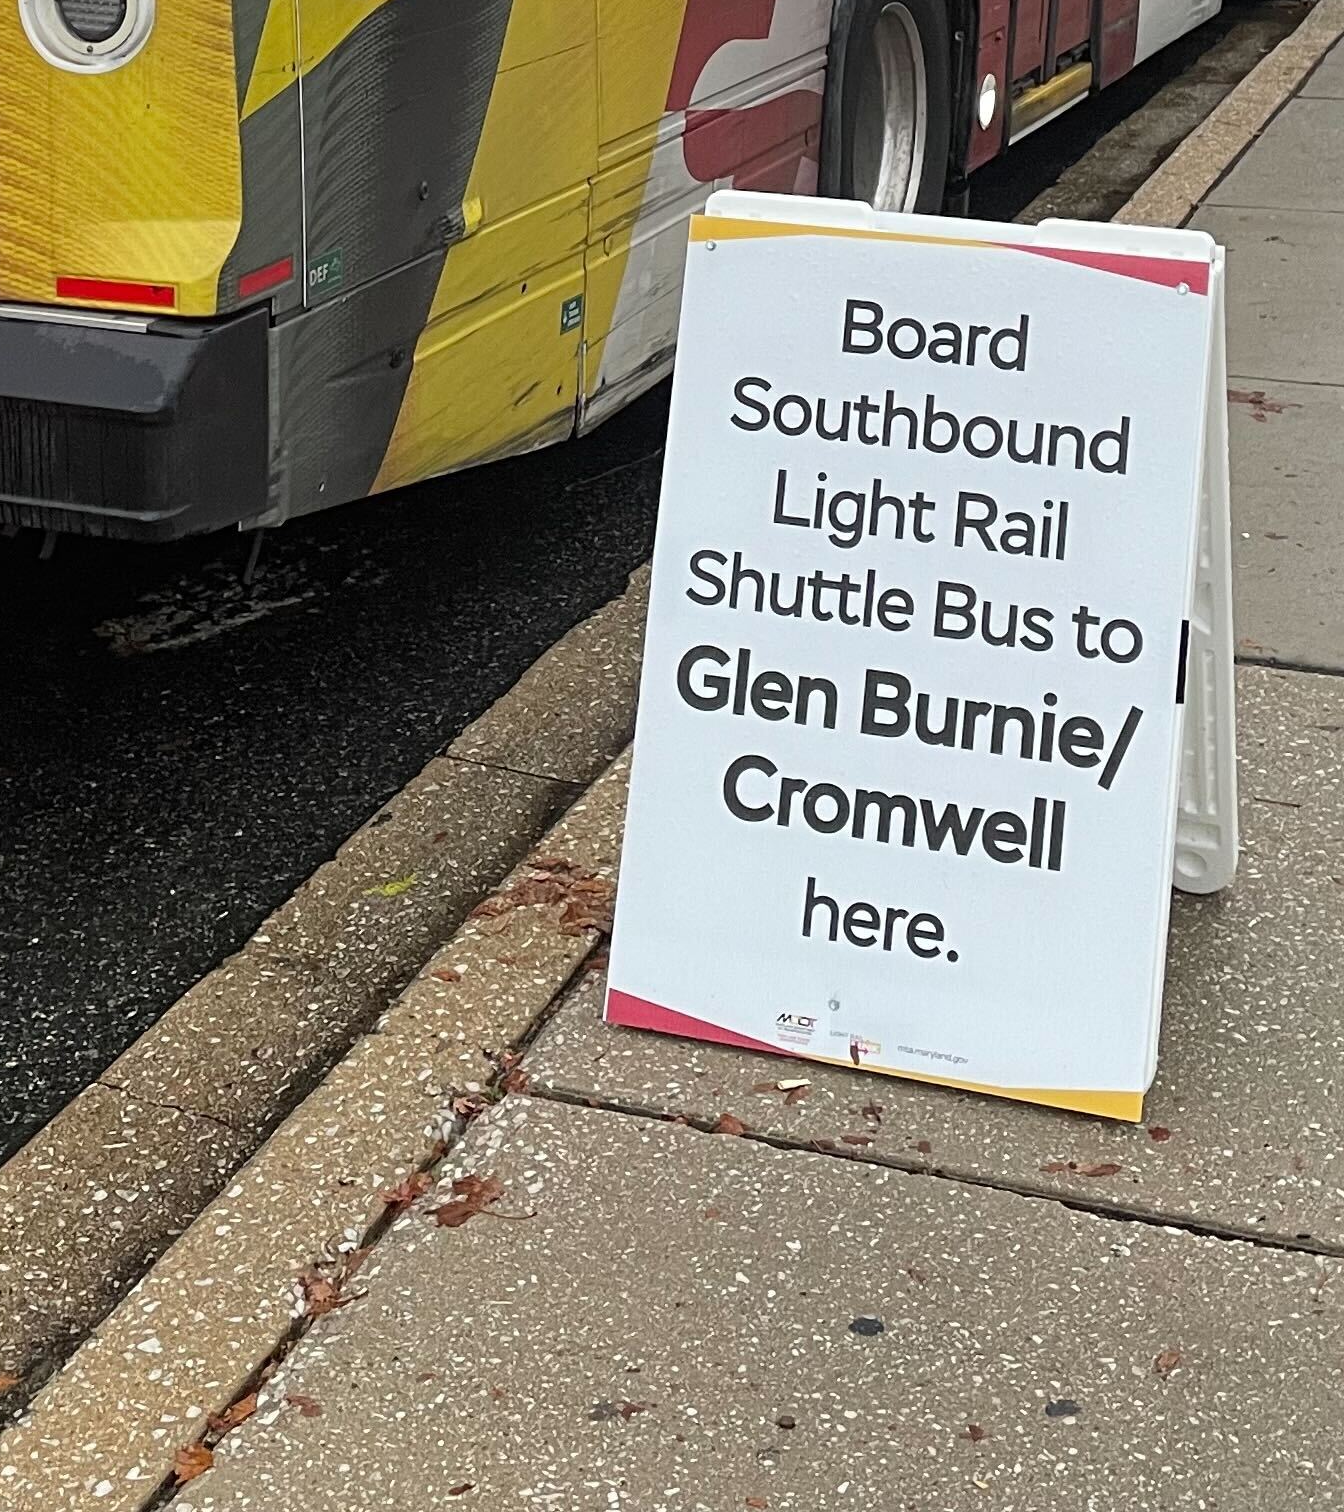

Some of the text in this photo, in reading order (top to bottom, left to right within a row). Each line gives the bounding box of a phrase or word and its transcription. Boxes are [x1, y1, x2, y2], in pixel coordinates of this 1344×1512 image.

[309, 263, 329, 287] DEF
[841, 298, 1030, 372] Board
[729, 376, 1131, 475] Southbound
[772, 468, 1069, 561] Light Rail
[685, 549, 1144, 664] Shuttle Bus to
[676, 644, 1144, 791] Glen Burnie/
[723, 754, 1066, 872] Cromwell
[801, 876, 960, 964] here.
